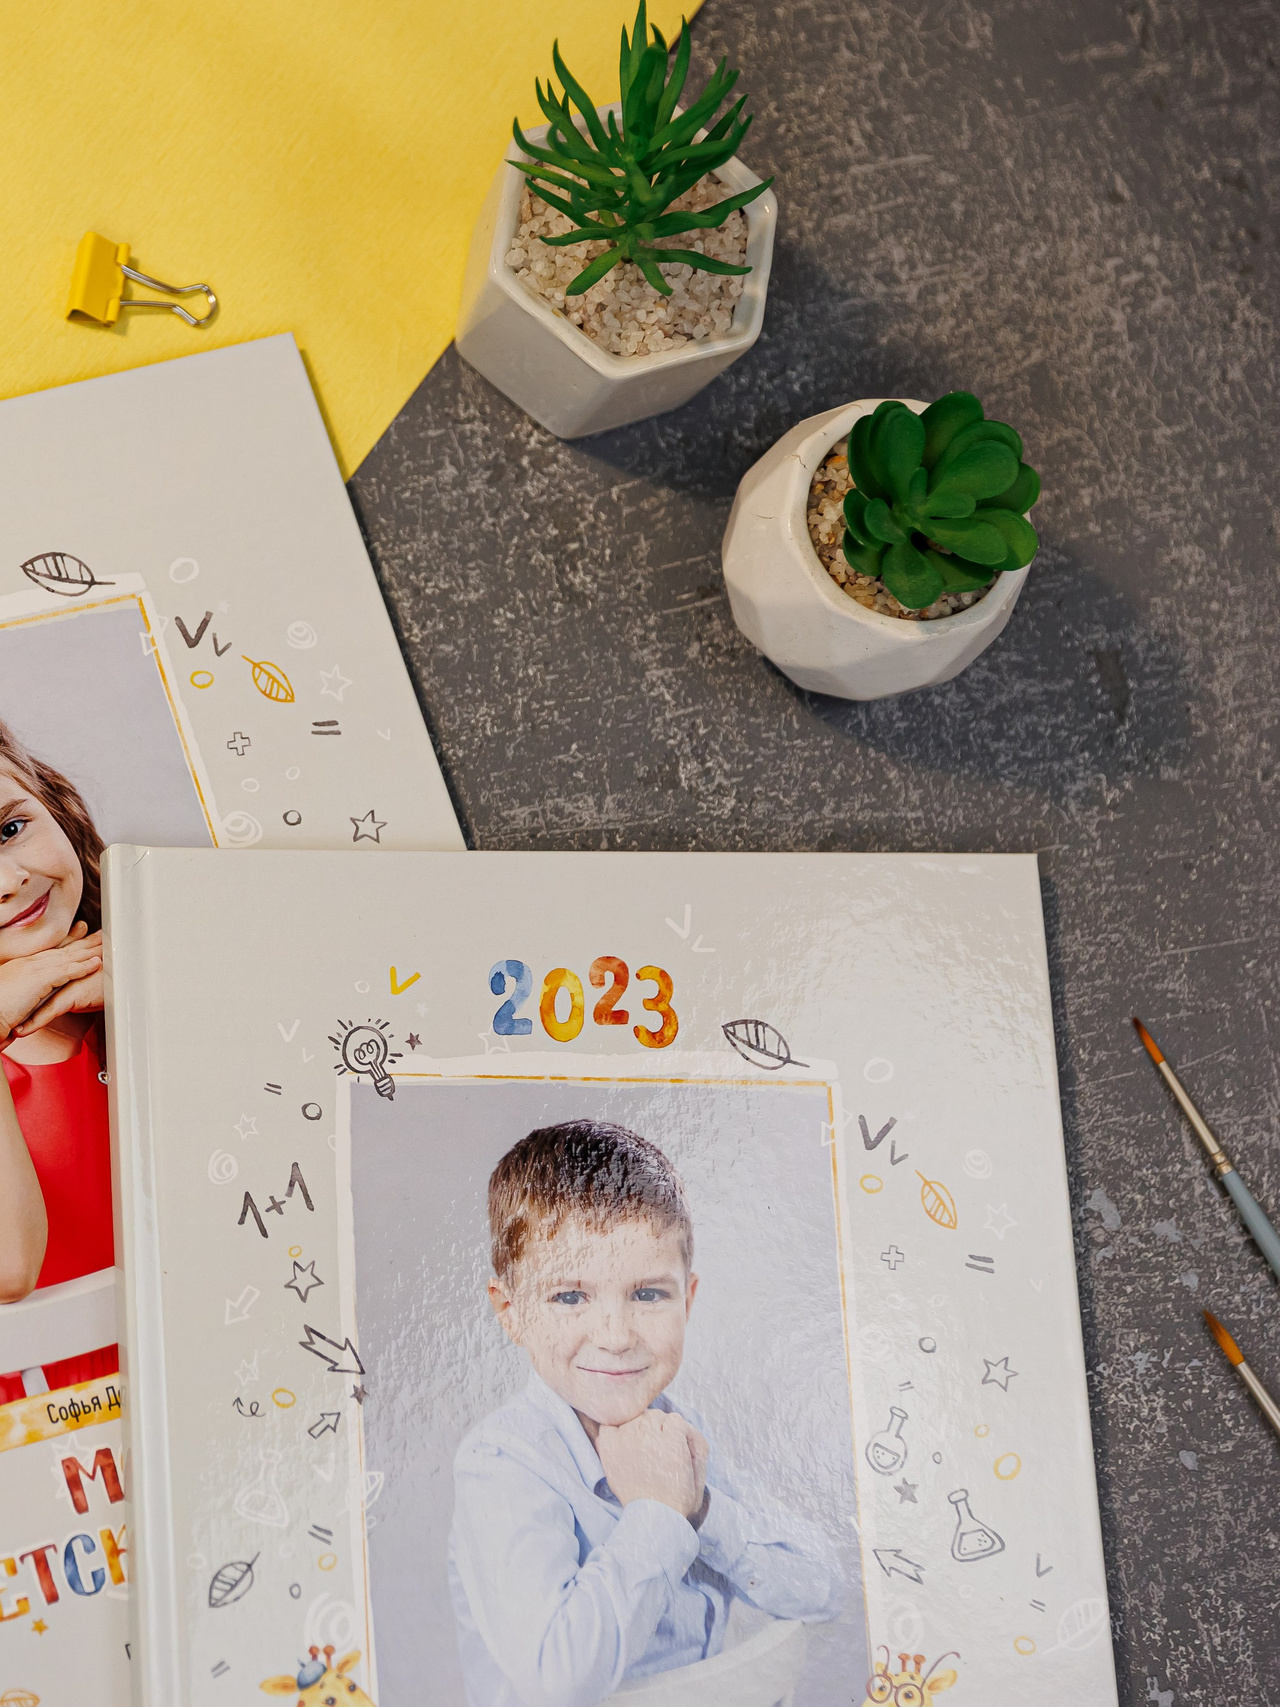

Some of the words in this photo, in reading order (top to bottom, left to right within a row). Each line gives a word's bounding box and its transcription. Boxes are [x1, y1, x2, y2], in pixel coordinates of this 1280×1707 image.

[488, 955, 679, 1049] 2023
[46, 1397, 102, 1424] Софья
[61, 1447, 125, 1516] М
